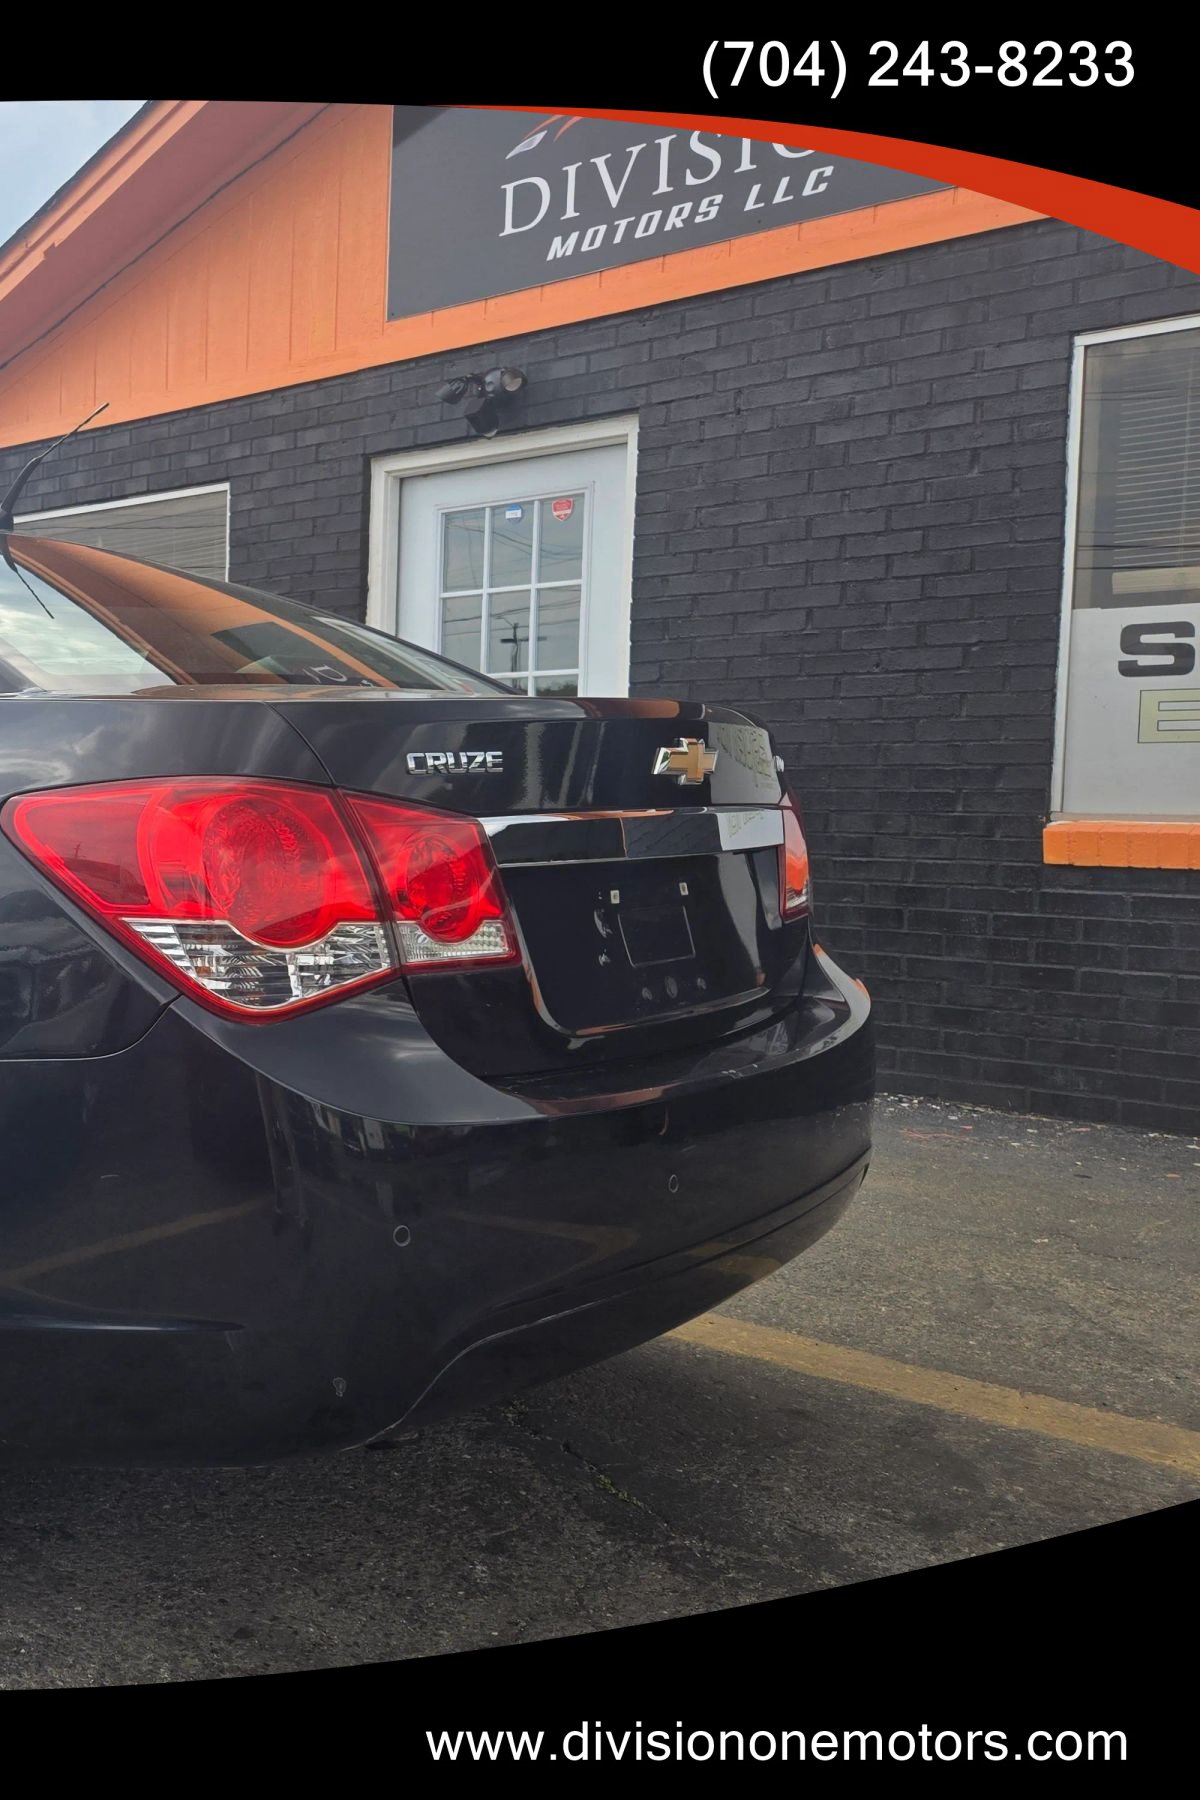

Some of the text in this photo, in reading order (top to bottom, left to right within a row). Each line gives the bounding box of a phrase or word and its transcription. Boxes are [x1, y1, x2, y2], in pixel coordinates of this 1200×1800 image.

[499, 130, 816, 236] DIVISI
[546, 165, 834, 261] MOTORS LLC
[406, 751, 504, 775] CRUZE
